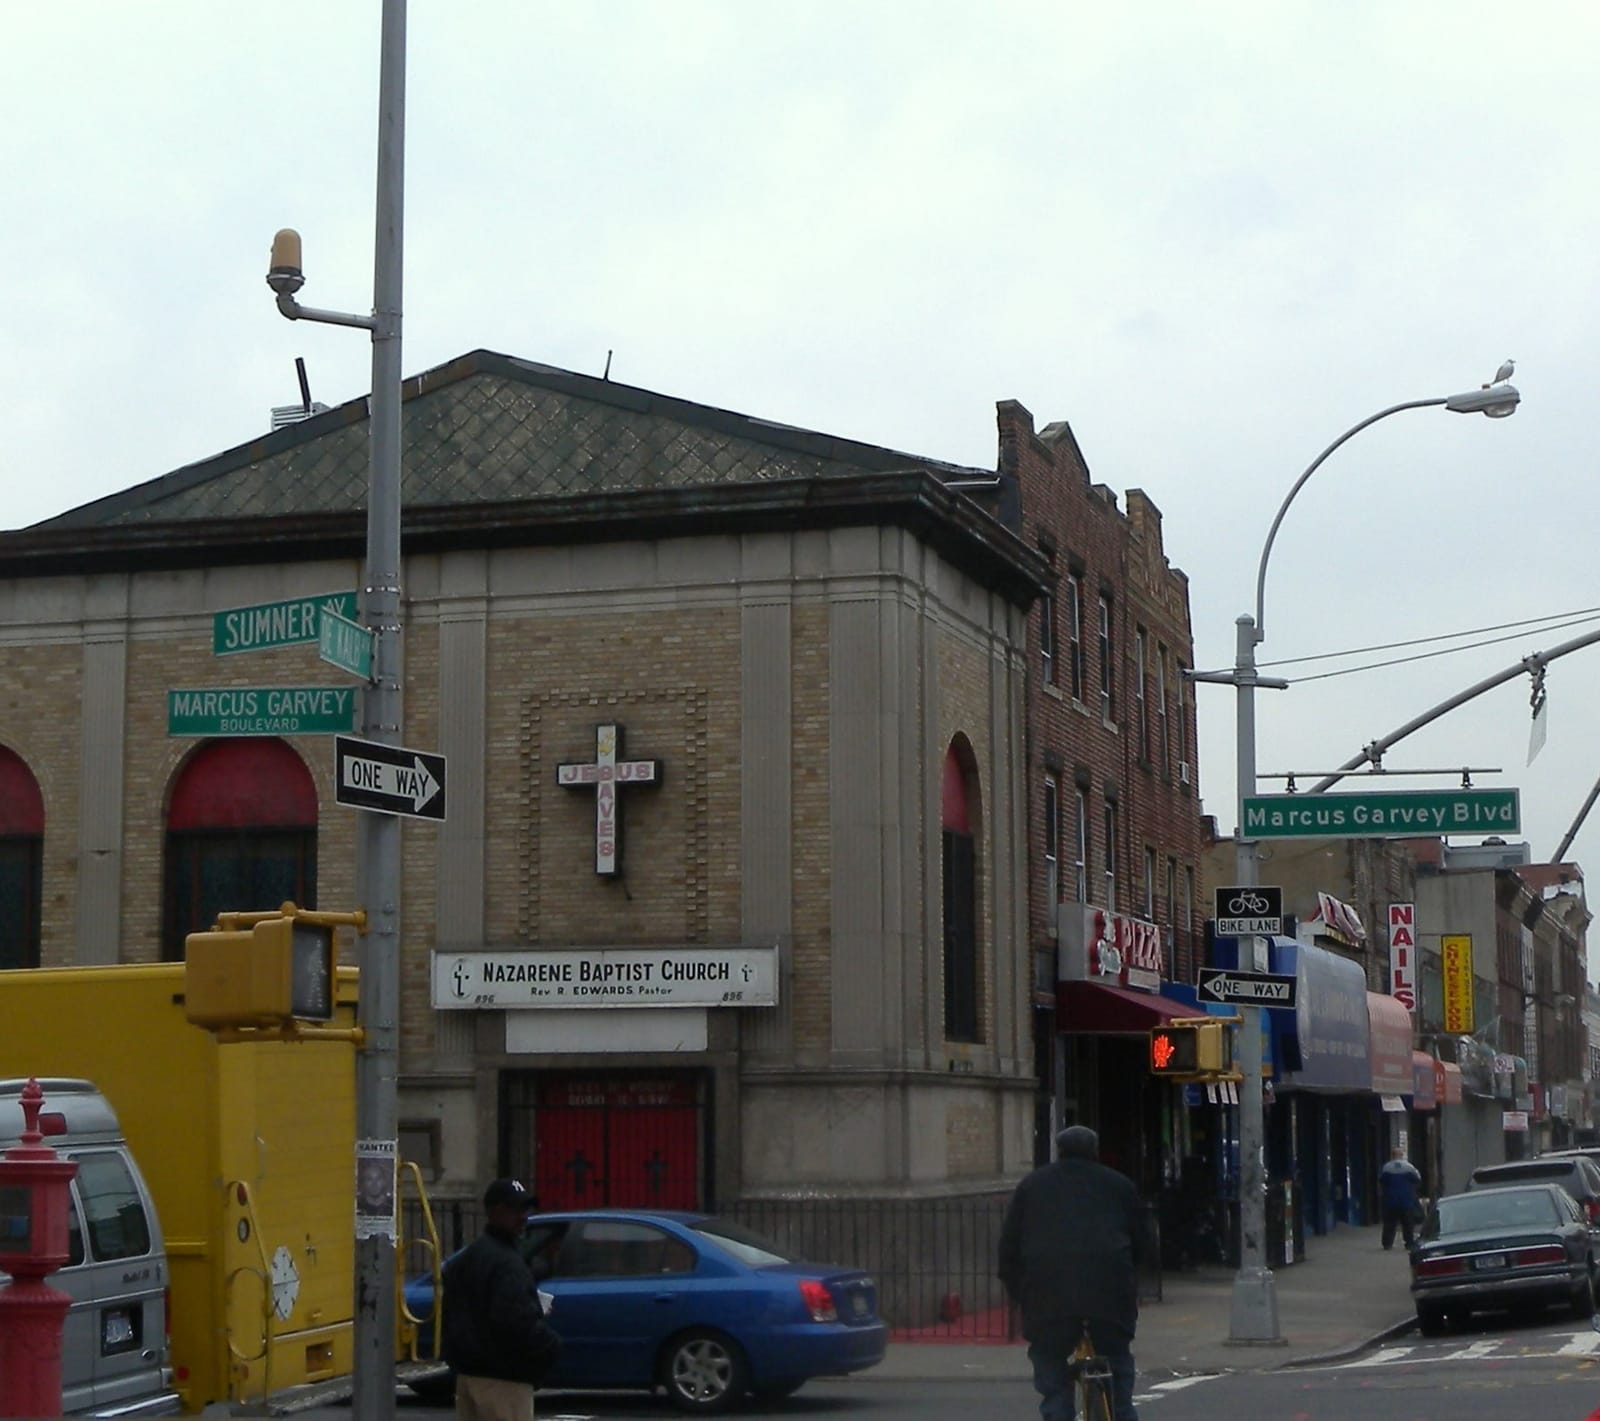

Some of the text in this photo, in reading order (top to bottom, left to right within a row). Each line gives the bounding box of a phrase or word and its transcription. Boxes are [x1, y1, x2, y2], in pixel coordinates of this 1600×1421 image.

[225, 602, 315, 648] SUMNER
[174, 691, 348, 716] MARCUS GARVEY
[221, 718, 299, 731] BOULEVARD
[352, 761, 429, 797] ONE WAY
[563, 763, 651, 782] JESUS
[599, 765, 615, 857] SAVES
[1248, 802, 1513, 827] Marcus Garvey Blvd
[1220, 920, 1278, 932] BIKE LANE
[1121, 918, 1164, 972] PIZZA
[1391, 906, 1414, 1010] NAILS
[483, 960, 729, 982] NAZARENE BAPTIST CHURCH
[573, 986, 633, 995] EDWARDS
[638, 985, 673, 995] Pastor
[722, 992, 743, 1001] 896
[1213, 979, 1284, 997] ONE WAY
